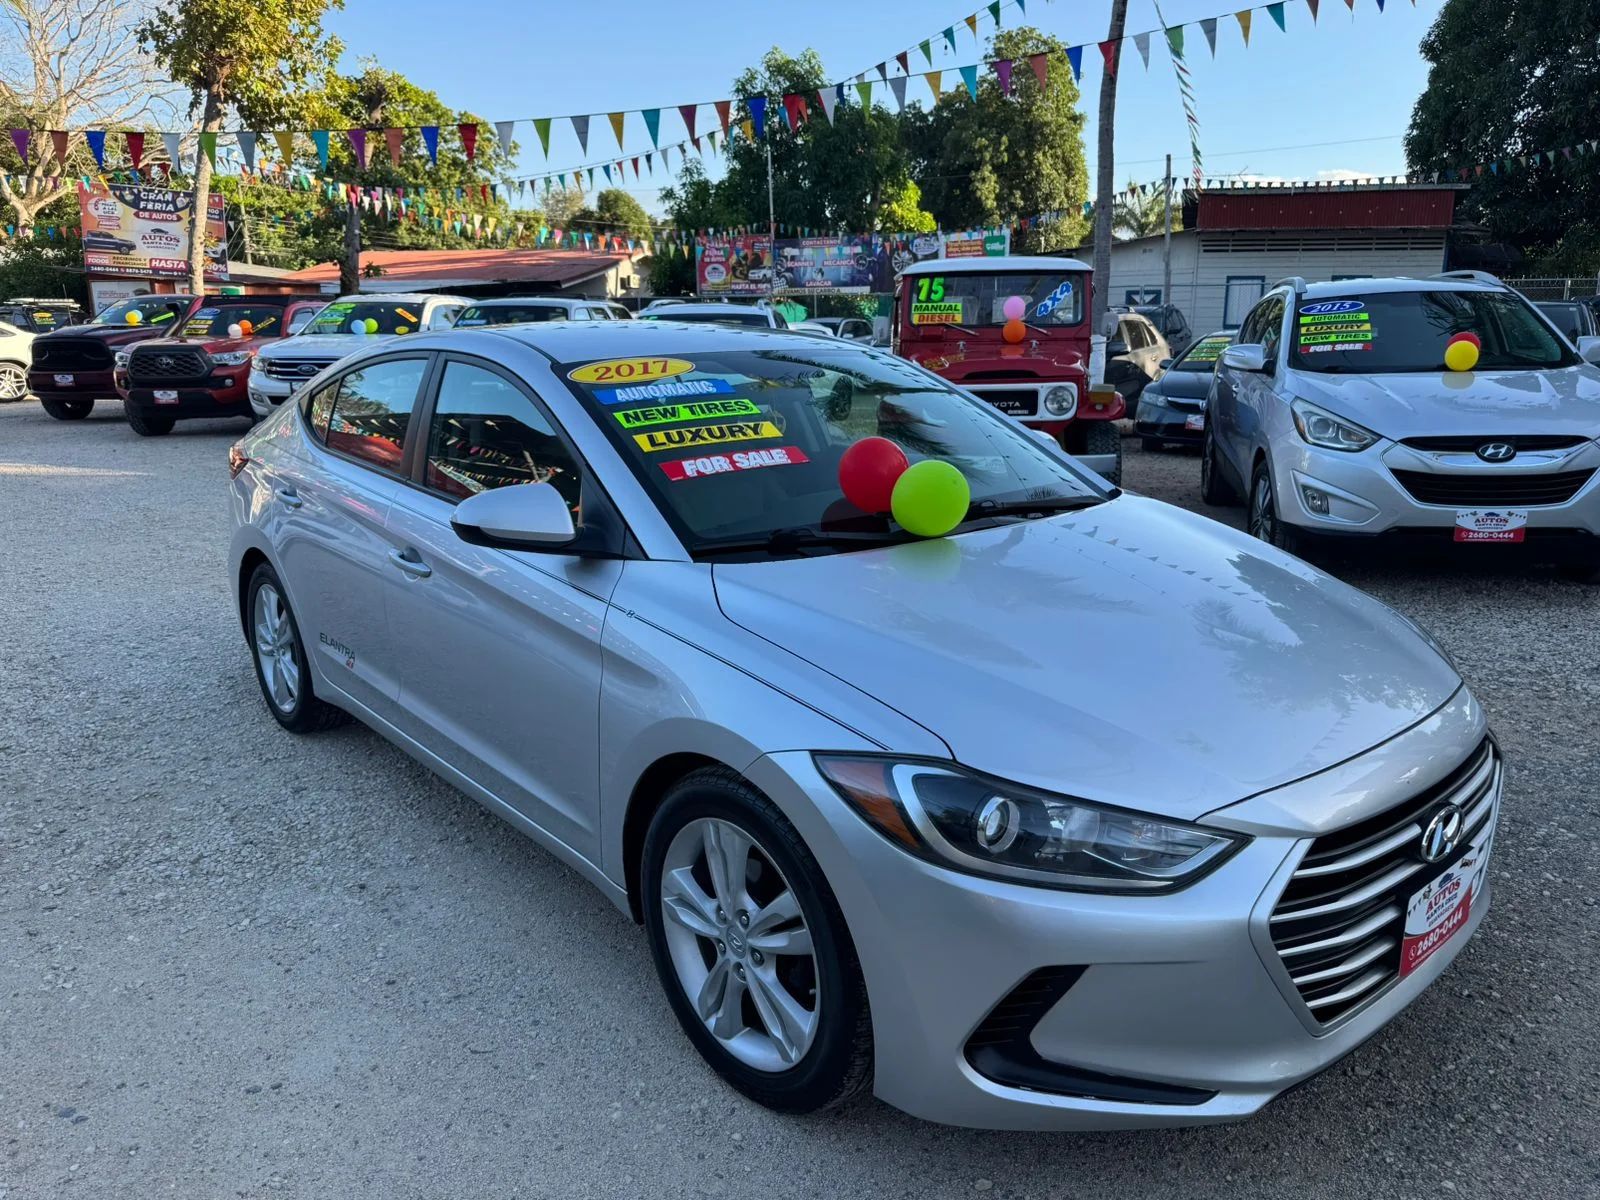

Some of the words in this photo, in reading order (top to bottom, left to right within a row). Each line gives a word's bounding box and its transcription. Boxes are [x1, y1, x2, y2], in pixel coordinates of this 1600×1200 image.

[140, 191, 173, 202] GRAN
[140, 201, 174, 211] FERIA
[152, 212, 178, 221] AUTOS
[141, 234, 180, 243] AUTOS
[152, 259, 187, 269] HASTA
[913, 304, 961, 312] MANUAL
[1312, 303, 1351, 312] 2015
[917, 314, 957, 323] DIESEL
[1310, 314, 1361, 322] AUTOMATIC
[1306, 324, 1363, 332] LUXURY
[1303, 335, 1330, 343] NEW
[593, 359, 670, 381] 2017
[615, 380, 717, 402] AUTOMATIC
[623, 406, 680, 424] NEW
[683, 400, 751, 417] TIRES
[647, 423, 764, 448] LUXURY
[682, 455, 733, 477] FOR
[735, 449, 791, 469] SALE
[319, 632, 356, 662] ELANTRA
[1425, 877, 1461, 916] AUTOS
[1416, 906, 1463, 956] 2680-0444
